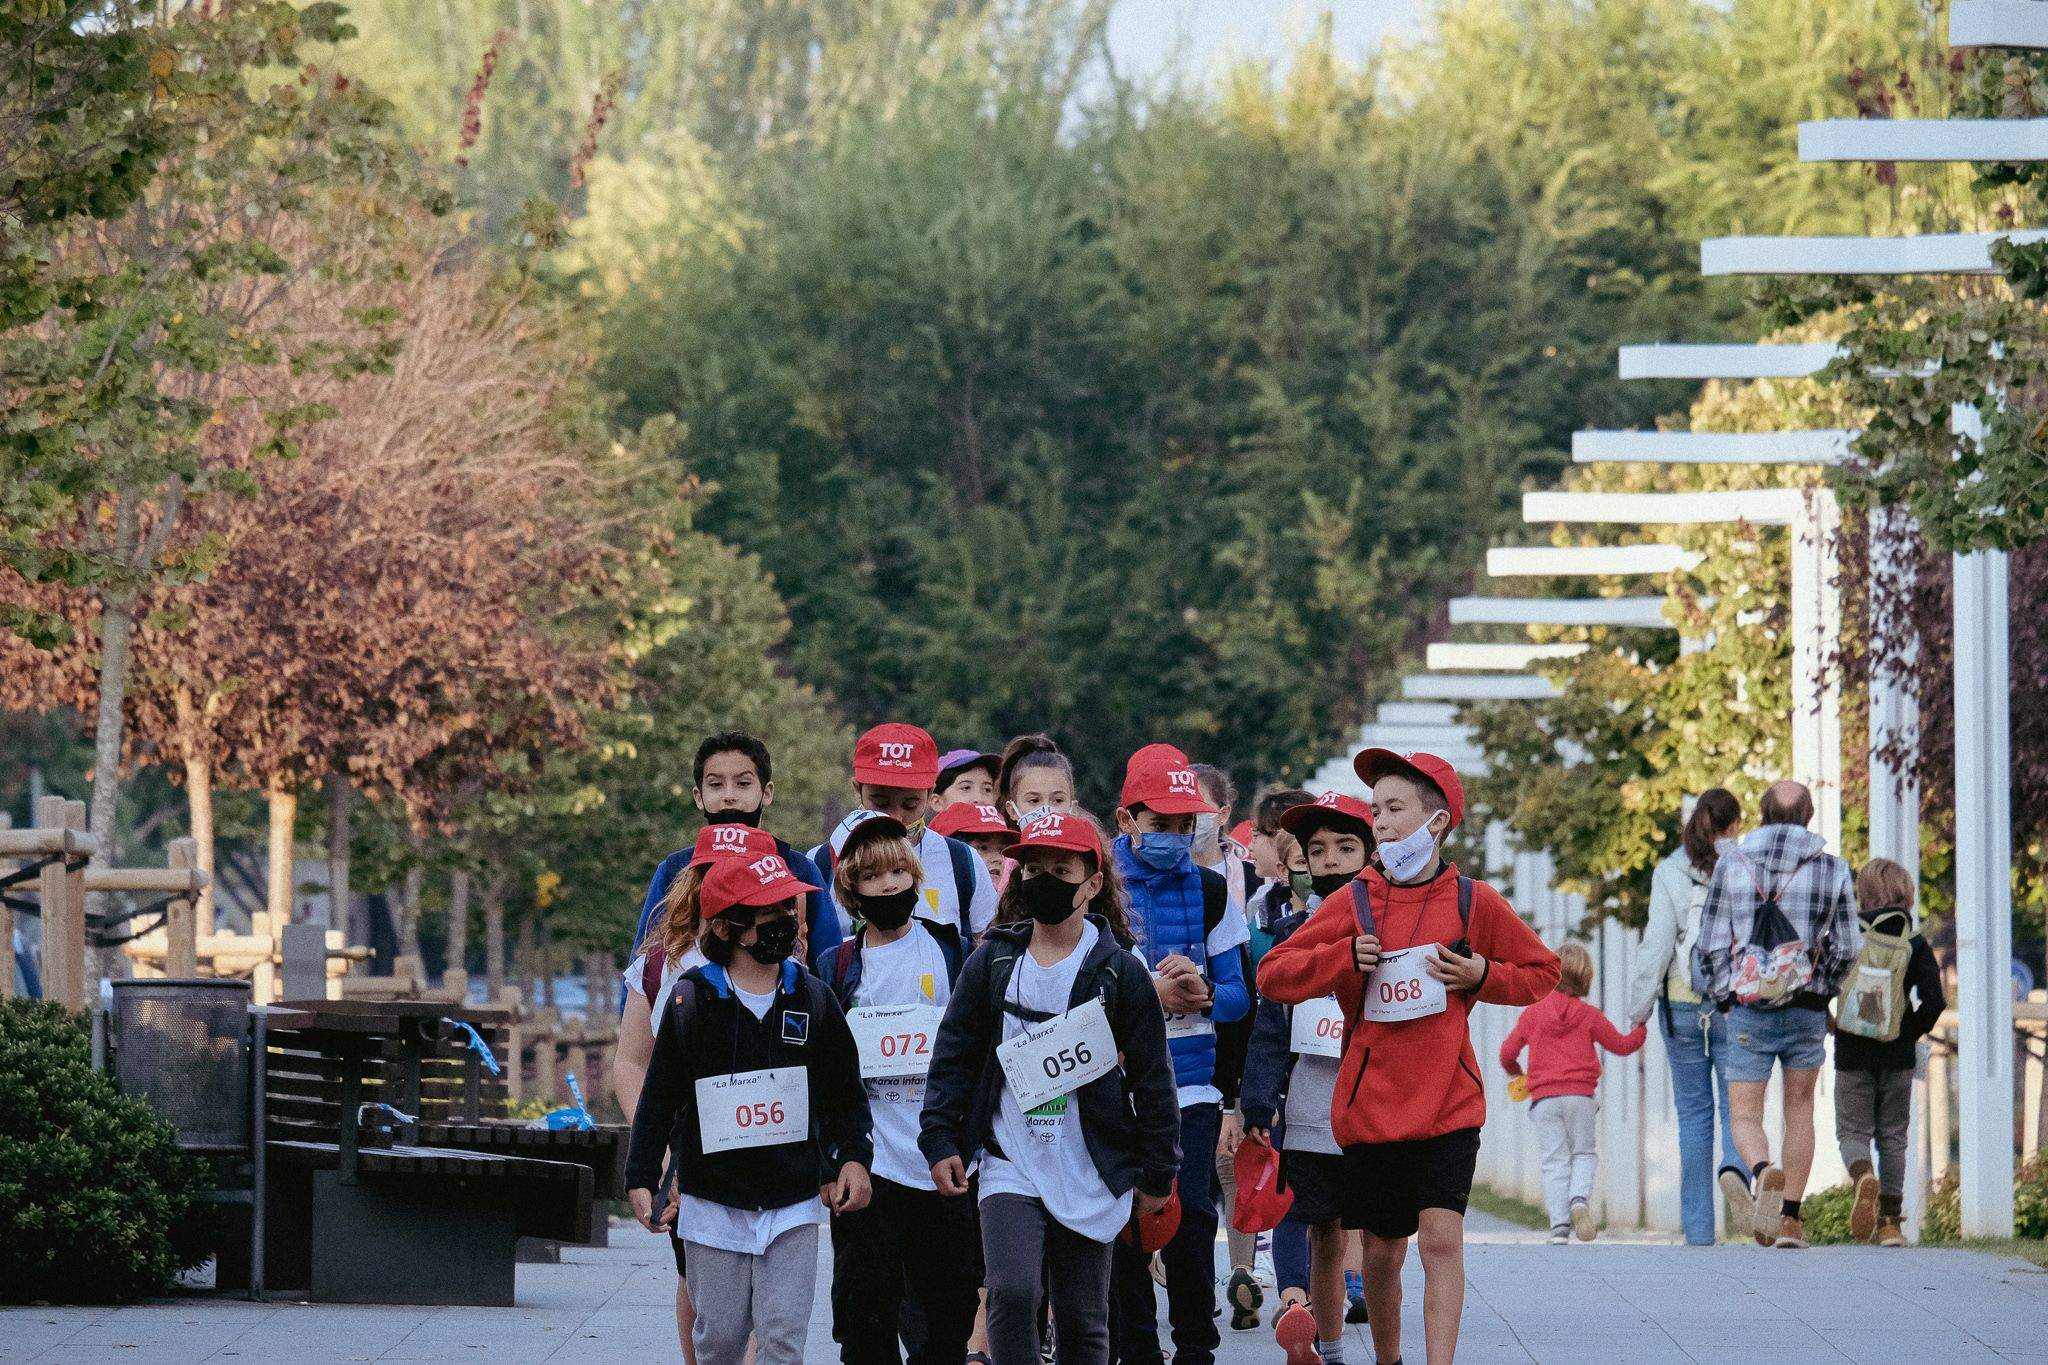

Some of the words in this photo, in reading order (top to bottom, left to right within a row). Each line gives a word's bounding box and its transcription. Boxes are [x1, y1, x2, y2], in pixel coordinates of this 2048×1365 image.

[879, 743, 914, 759] TOT
[895, 759, 913, 769] Cugat
[1167, 771, 1195, 787] TOT
[1031, 813, 1065, 832] TOT
[713, 827, 749, 845] TOT
[712, 843, 726, 851] Sant
[727, 844, 748, 854] Cugat
[749, 855, 782, 877] TOT
[1380, 978, 1422, 1003] 068
[880, 1033, 929, 1057] 072
[1042, 1041, 1092, 1079] 056
[735, 1101, 785, 1128] 056
